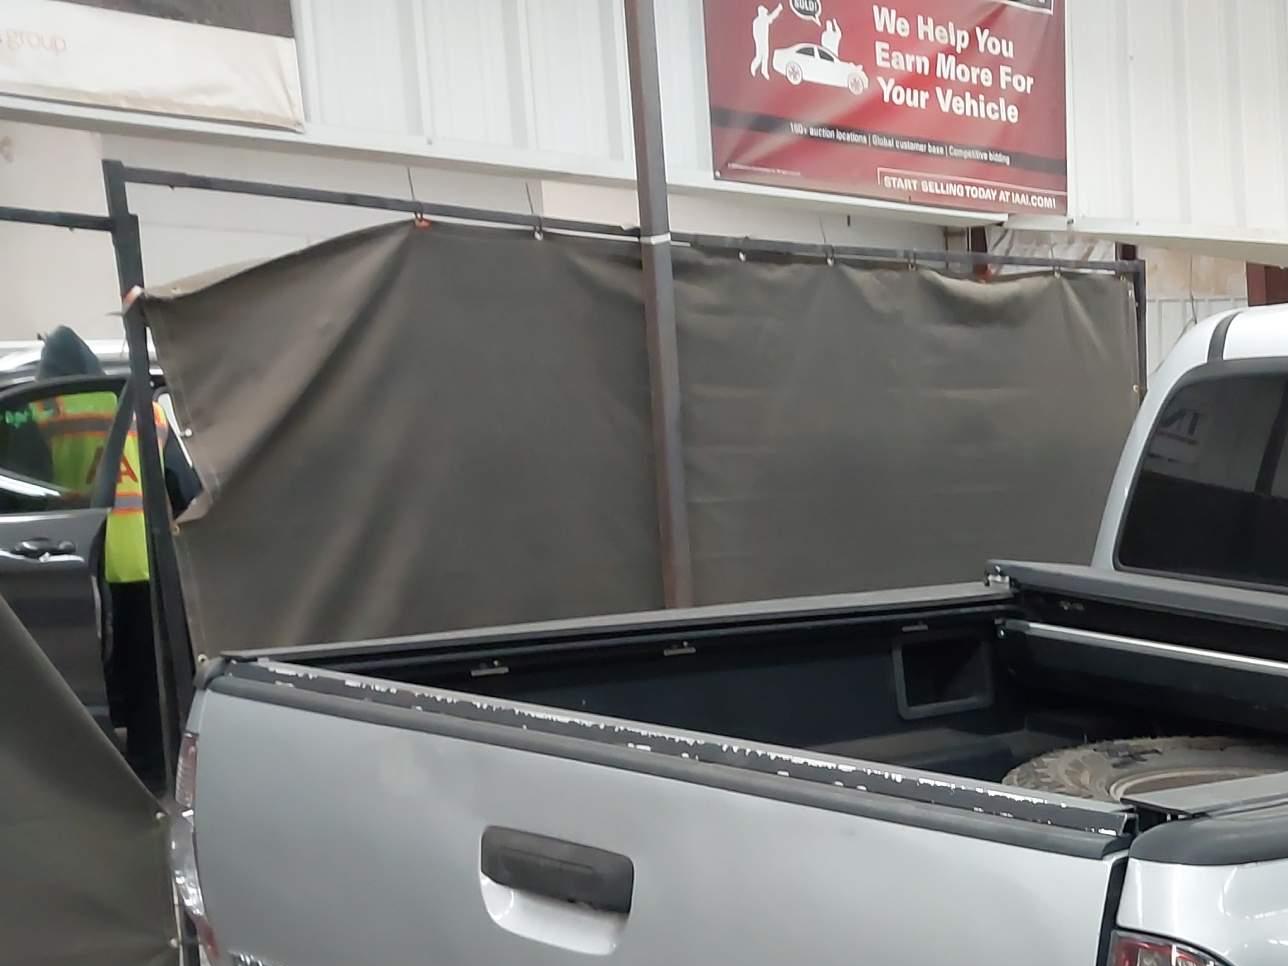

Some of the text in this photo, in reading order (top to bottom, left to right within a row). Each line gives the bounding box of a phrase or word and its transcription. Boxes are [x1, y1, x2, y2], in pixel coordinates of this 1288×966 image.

[872, 4, 1014, 59] We Help You
[875, 42, 1035, 94] Earn More For
[877, 76, 1019, 124] Your Vehicle
[809, 126, 835, 139] auction
[836, 128, 868, 145] locations
[872, 134, 894, 149] Global
[895, 139, 927, 153] customer
[927, 142, 944, 155] base
[949, 145, 988, 160] Competitive
[988, 150, 1010, 166] bidding
[883, 175, 918, 191] START
[921, 180, 965, 197] SELLING
[965, 185, 998, 201] TODAY
[999, 190, 1012, 203] AT
